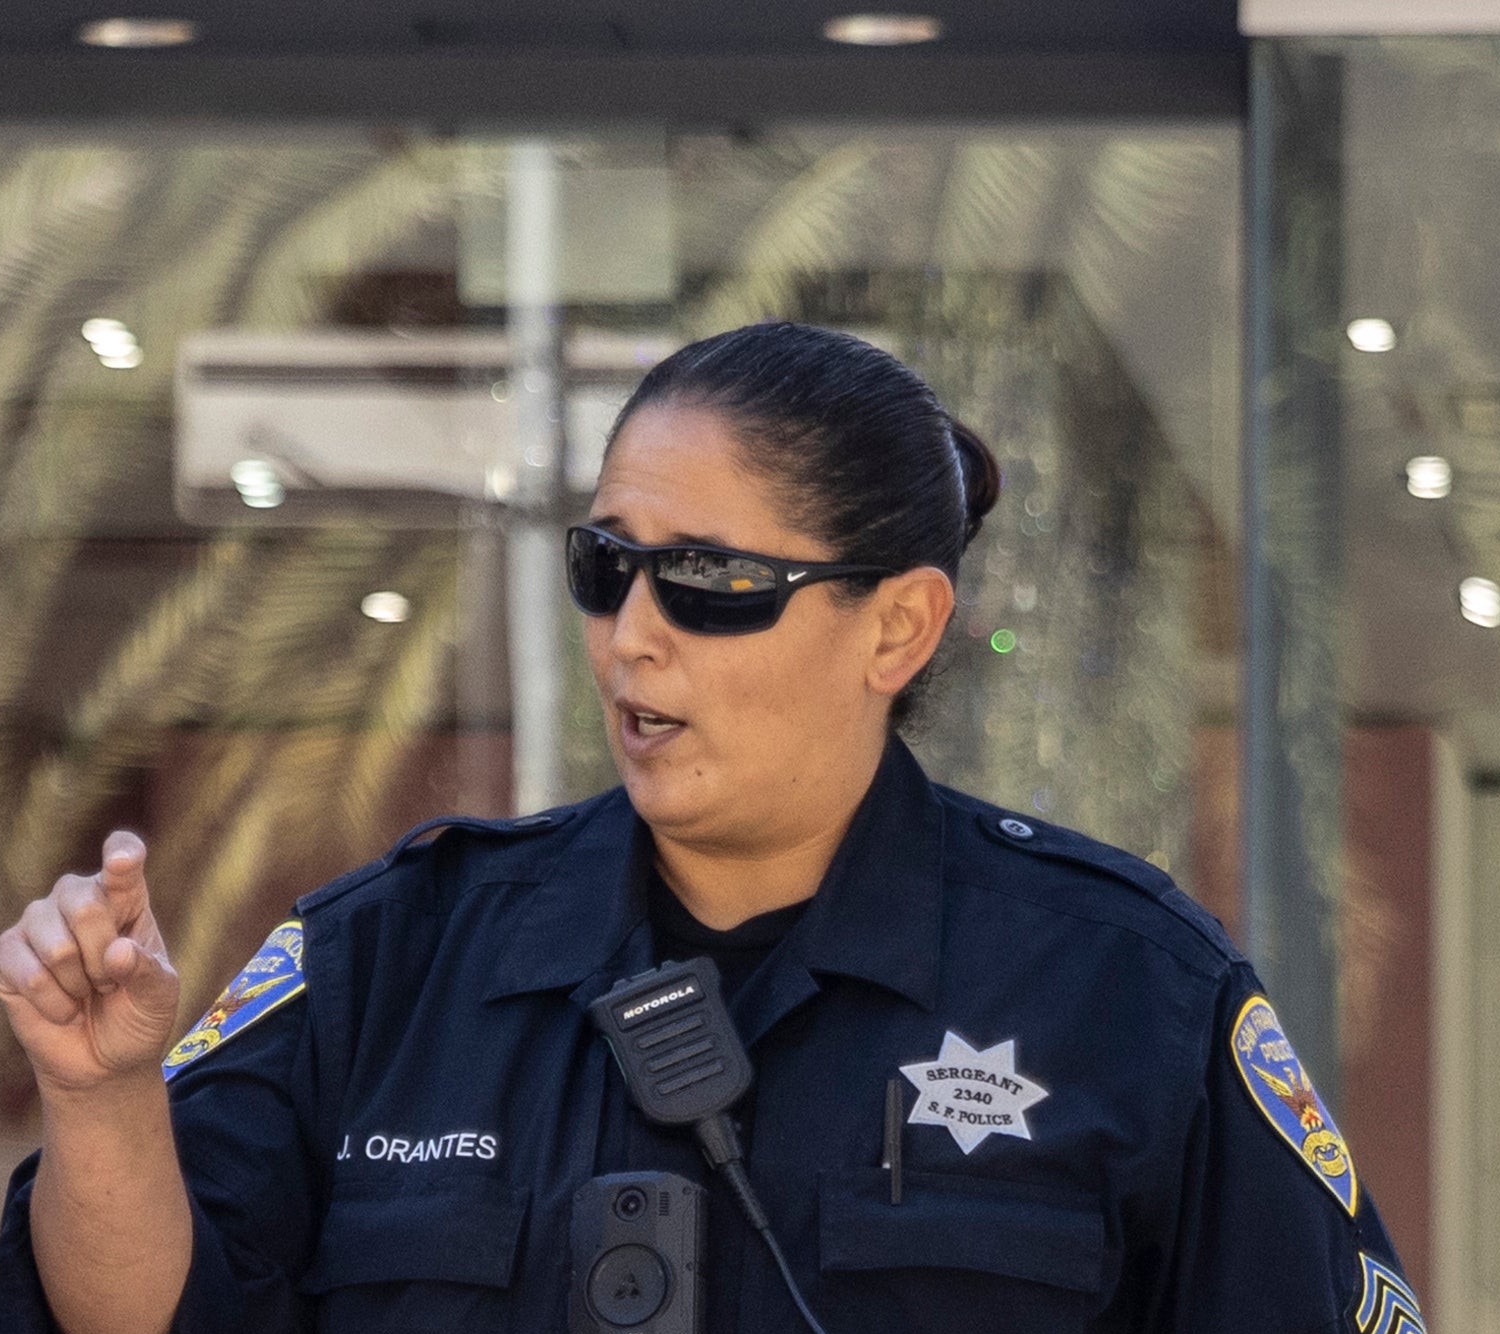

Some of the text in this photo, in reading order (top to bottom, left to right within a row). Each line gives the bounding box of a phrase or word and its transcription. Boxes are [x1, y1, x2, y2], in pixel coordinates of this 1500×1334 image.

[623, 986, 694, 1020] MOTOROLA
[926, 1067, 1024, 1097] SERGEANT
[953, 1088, 994, 1106] 2340
[927, 1101, 1014, 1127] S. F. POLICE
[336, 1132, 498, 1164] J. ORANTES
